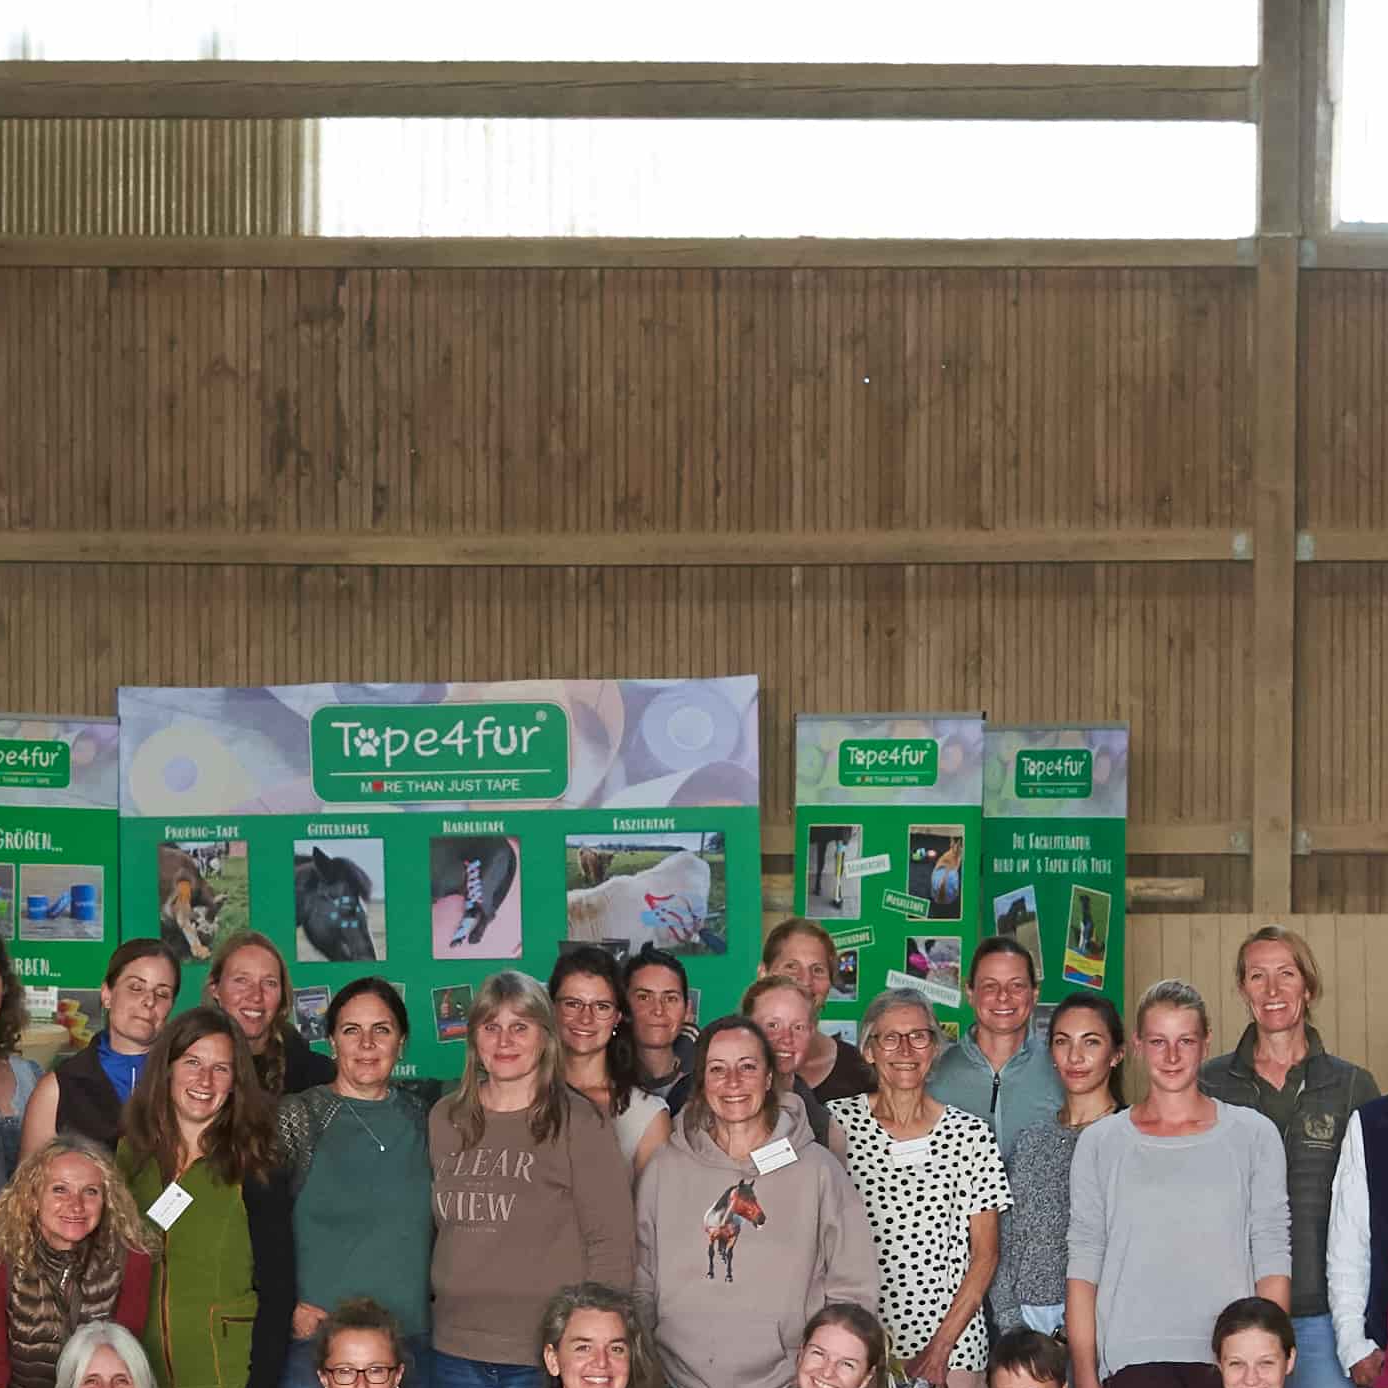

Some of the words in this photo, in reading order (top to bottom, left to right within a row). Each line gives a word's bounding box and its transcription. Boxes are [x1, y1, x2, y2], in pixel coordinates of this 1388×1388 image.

[406, 780, 444, 793] THAN
[447, 779, 482, 793] JUST
[485, 778, 520, 792] TAPE
[436, 1191, 517, 1222] VIEW
